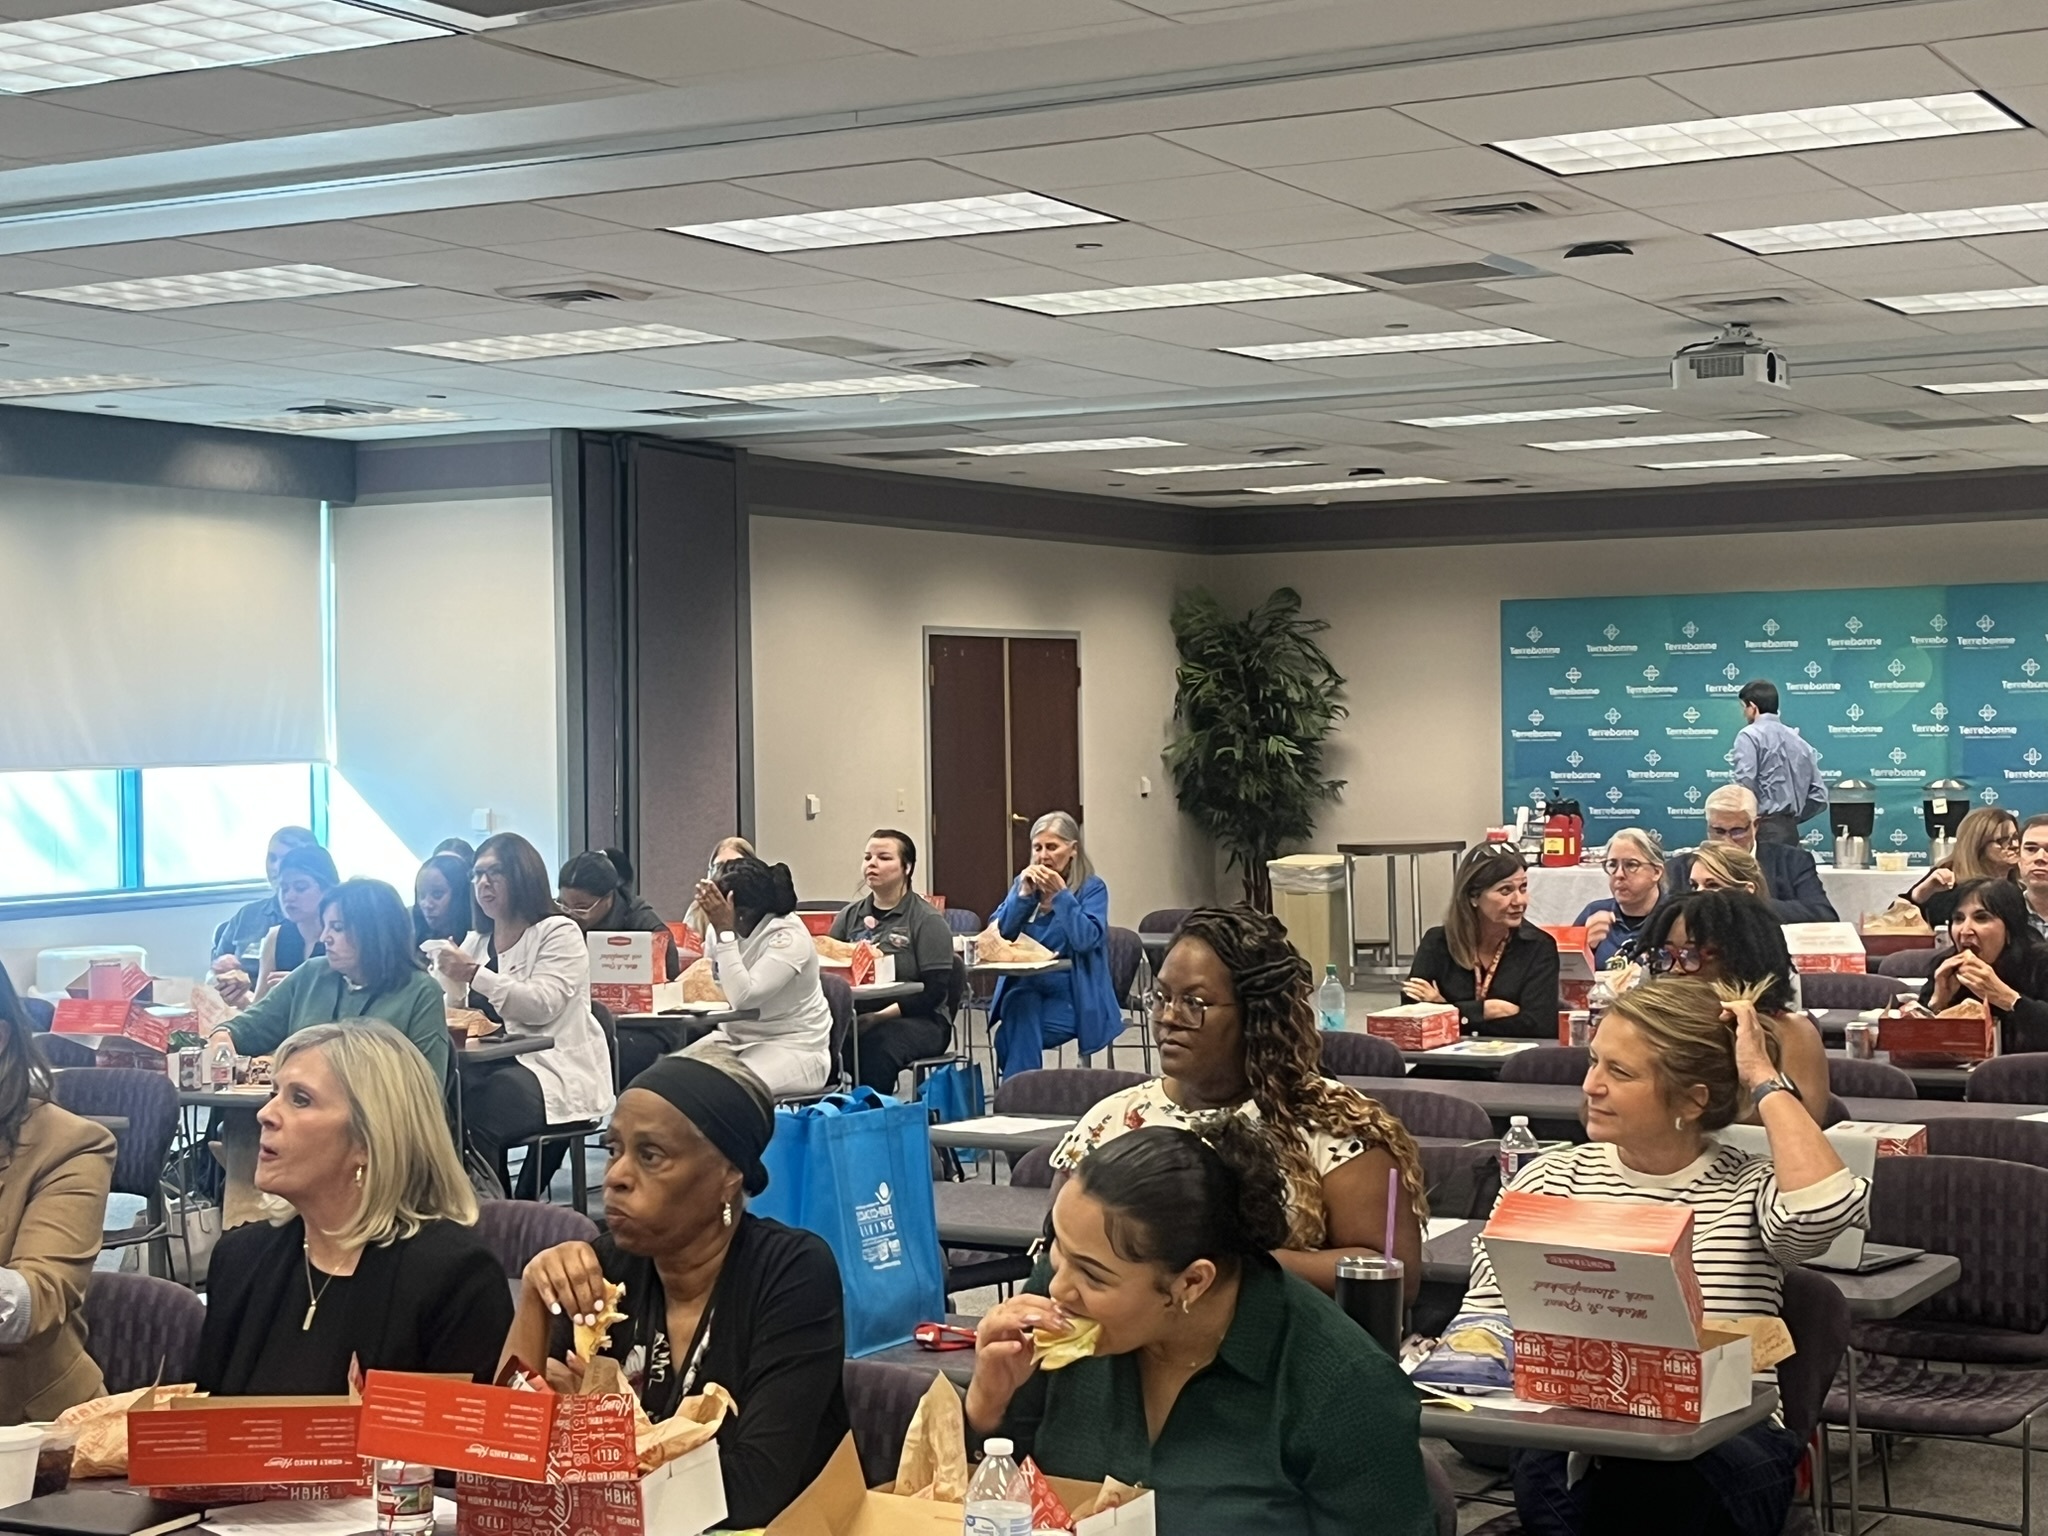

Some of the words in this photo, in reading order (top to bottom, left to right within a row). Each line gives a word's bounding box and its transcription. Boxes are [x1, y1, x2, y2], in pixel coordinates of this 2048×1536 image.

[1745, 639, 1798, 648] Terrebonne
[1827, 638, 1881, 646] Terrebonne
[1911, 636, 1948, 644] Terrebo
[1957, 636, 2015, 645] Terrebonne
[1510, 646, 1560, 654] Terrebonne
[1587, 644, 1638, 652] Terrebonne
[1665, 642, 1717, 650] Terrebonne
[1706, 684, 1743, 692] Terrebo
[1786, 682, 1841, 690] Terrebonne
[1869, 681, 1925, 689] Terrebonne
[2002, 681, 2048, 689] Terrebon
[1549, 687, 1600, 695] Terrebonne
[1626, 685, 1678, 694] Terrebonne
[1588, 728, 1639, 737] Terrebonne
[1666, 727, 1718, 736] Terrebonne
[1828, 725, 1883, 733] Terrebonne
[1912, 724, 1949, 733] Terrebo
[1959, 726, 2017, 734] Terrebonne
[1550, 771, 1601, 779] Terrebonne
[1627, 770, 1679, 778] Terrebonne
[1870, 769, 1926, 777] Terrebonne
[2004, 770, 2048, 778] Terrebon
[1589, 807, 1640, 815] Terrebonne
[1535, 1381, 1562, 1393] DELI
[1685, 1400, 1699, 1412] DE
[597, 1449, 619, 1461] DELI
[356, 1475, 372, 1486] DE
